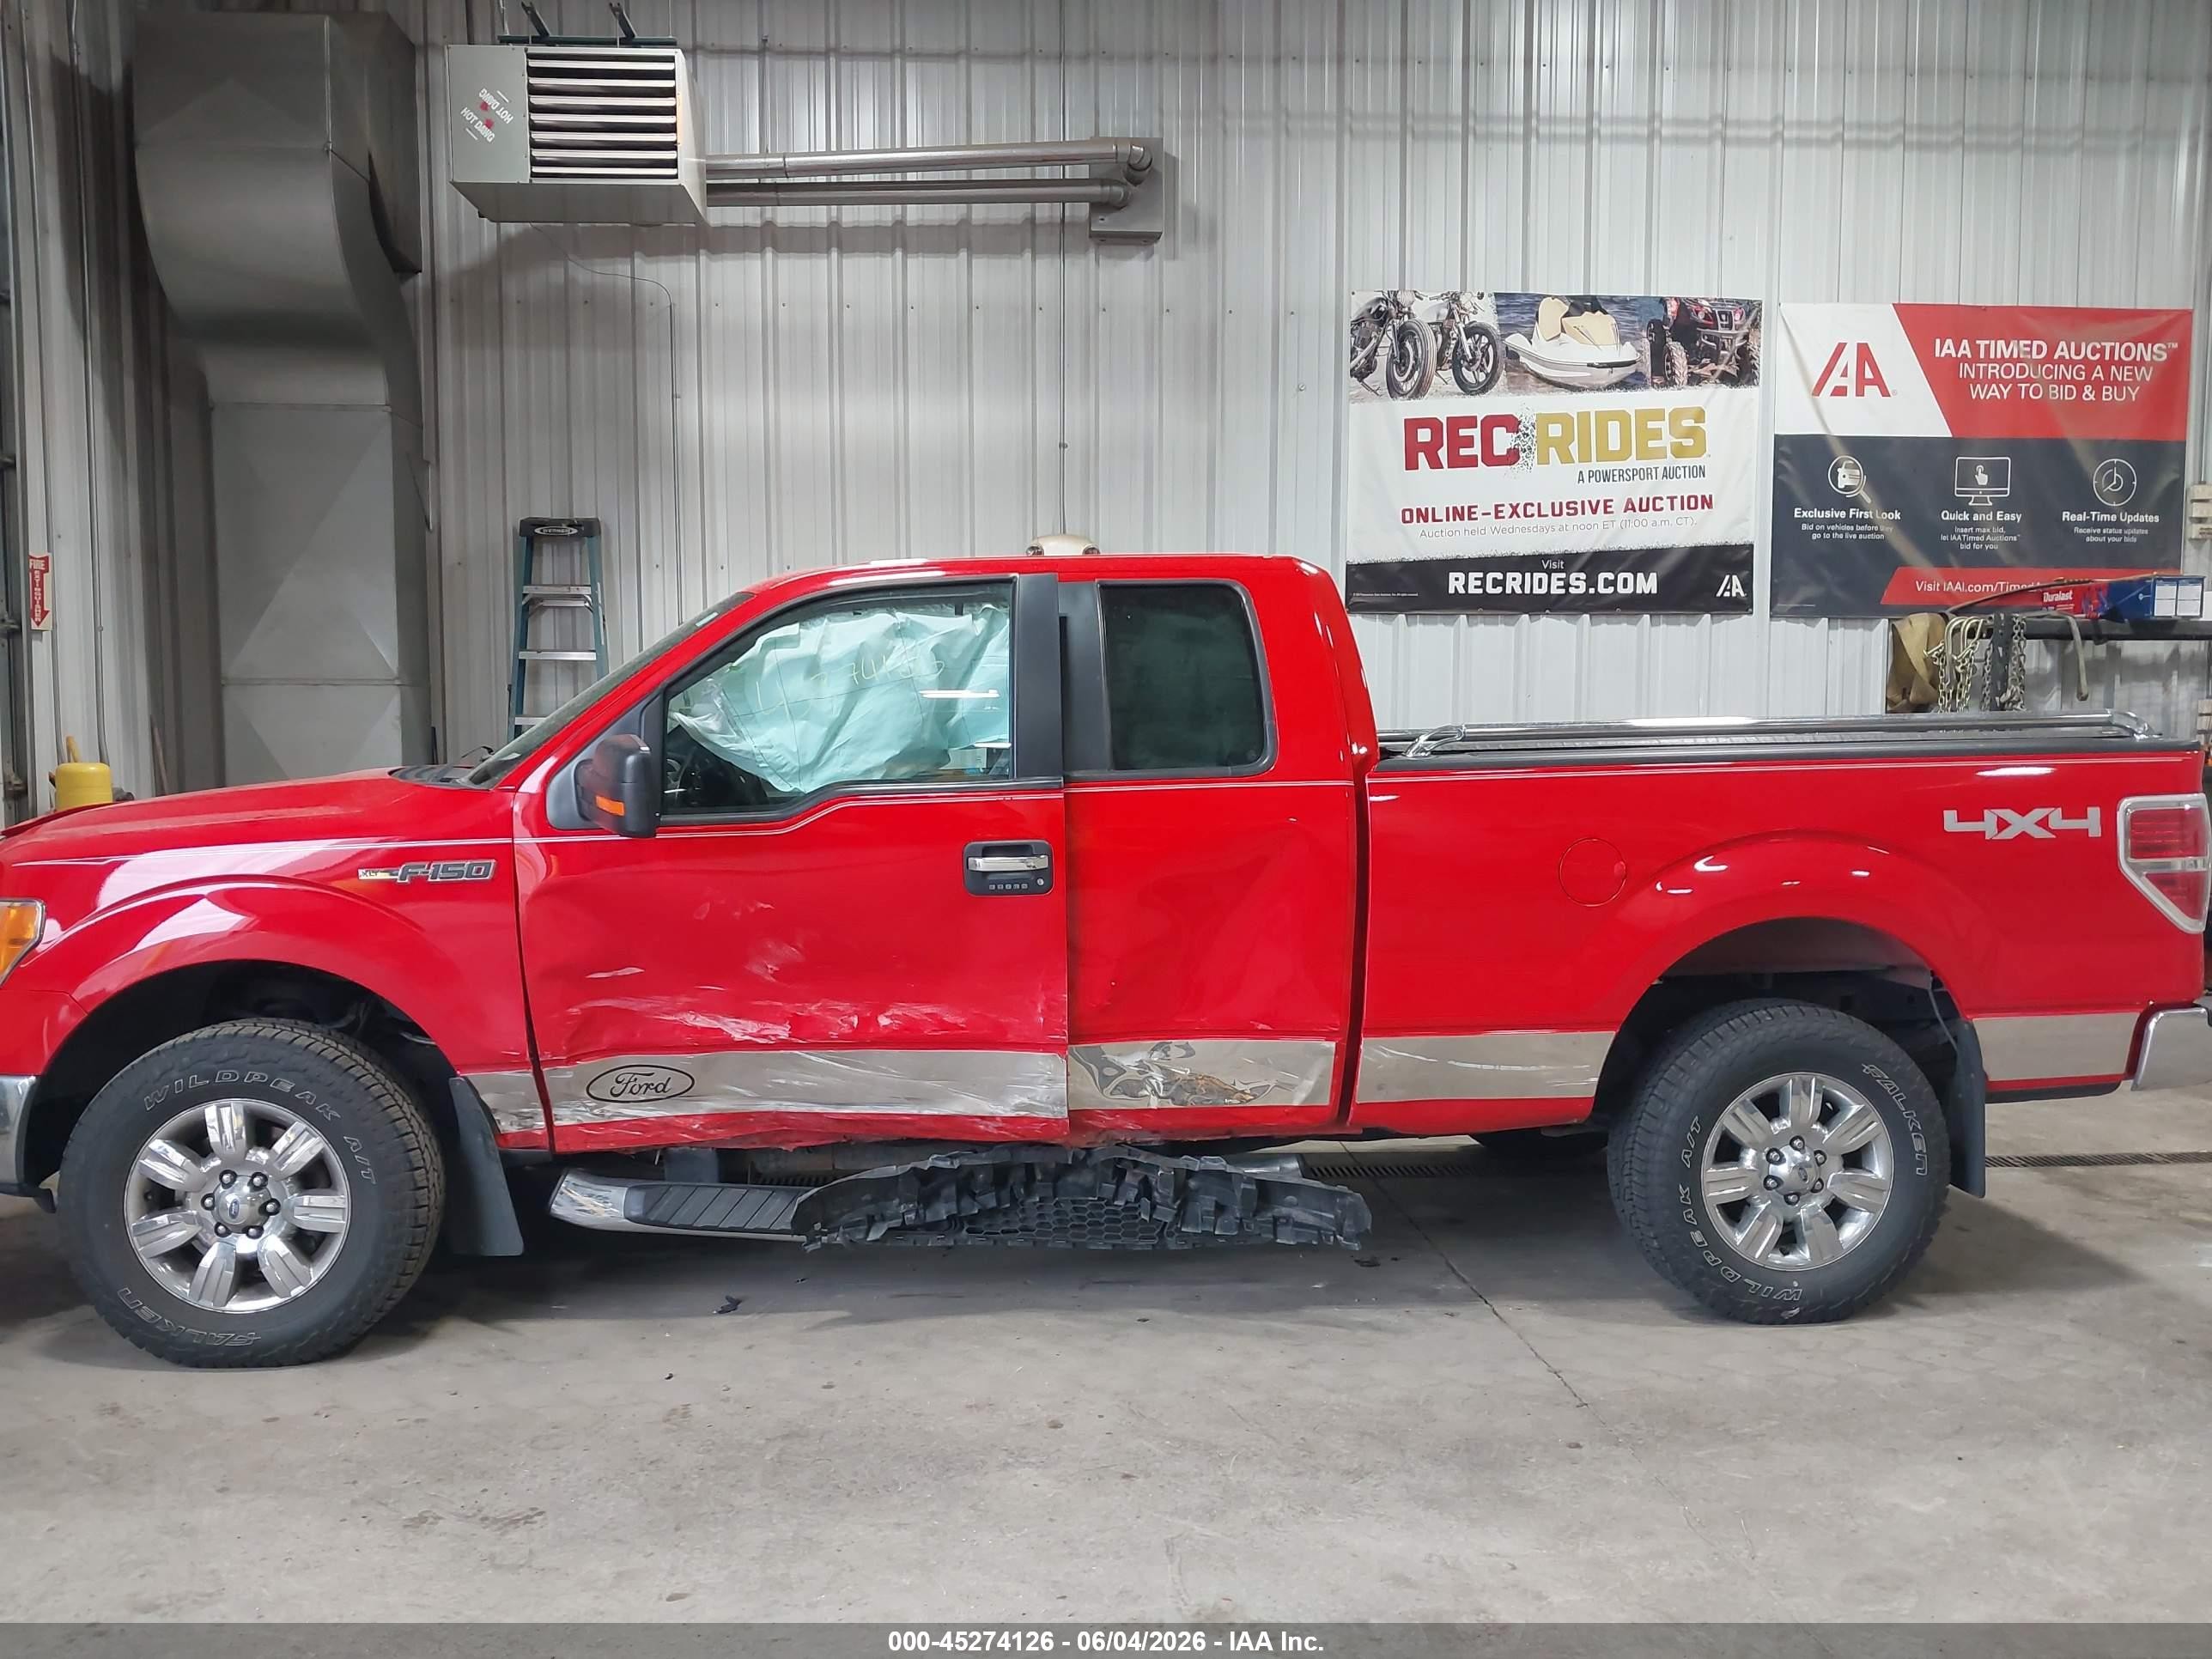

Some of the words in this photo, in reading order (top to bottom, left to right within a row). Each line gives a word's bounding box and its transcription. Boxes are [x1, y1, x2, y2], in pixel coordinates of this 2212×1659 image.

[460, 107, 478, 124] HOT
[495, 107, 514, 124] HOT
[1935, 338, 1972, 359] IAA
[1976, 339, 2048, 360] TIMED
[1959, 362, 2085, 380] INTRODUCING
[2091, 366, 2104, 380] A
[2110, 366, 2154, 381] NEW
[1970, 384, 2012, 399] WAY
[2017, 384, 2043, 399] TO
[2049, 386, 2076, 401] BID
[2082, 386, 2096, 401] &
[2102, 386, 2140, 402] BUY
[1536, 405, 1707, 465] RIDES
[1577, 470, 1585, 483] A
[1589, 466, 1659, 483] POWERSPORT
[1662, 465, 1705, 480] AUCTION
[1401, 499, 1614, 524] ONLINE-EXCLUSIVE
[1623, 495, 1714, 514] AUCTION
[1794, 507, 1846, 519] Exclusive
[1850, 508, 1873, 519] First
[1876, 509, 1901, 520] Look
[1941, 510, 1970, 521] Quick
[1972, 511, 1993, 521] and
[1996, 511, 2022, 523] Easy
[2062, 511, 2117, 521] Real-Time
[2119, 512, 2160, 524] Updates
[1419, 528, 1461, 538] Auction
[1464, 526, 1486, 537] held
[1490, 524, 1555, 535] Wednesdays
[1559, 523, 1569, 532] at
[1572, 522, 1599, 531] noon
[1603, 520, 1616, 529] ET
[1620, 518, 1648, 530] (11:00
[1651, 518, 1673, 527] a.m.
[1541, 559, 1565, 569] Visit
[1448, 571, 1658, 595] RECRIDES.COM
[1915, 580, 1940, 592] Visit
[2043, 589, 2073, 603] Duralast
[397, 859, 498, 884] F-150
[610, 1072, 672, 1098] Ford
[144, 1070, 342, 1121] WILDPEAK
[1862, 1063, 1928, 1176] FALKEN
[1679, 1183, 1803, 1302] WILDPEAK
